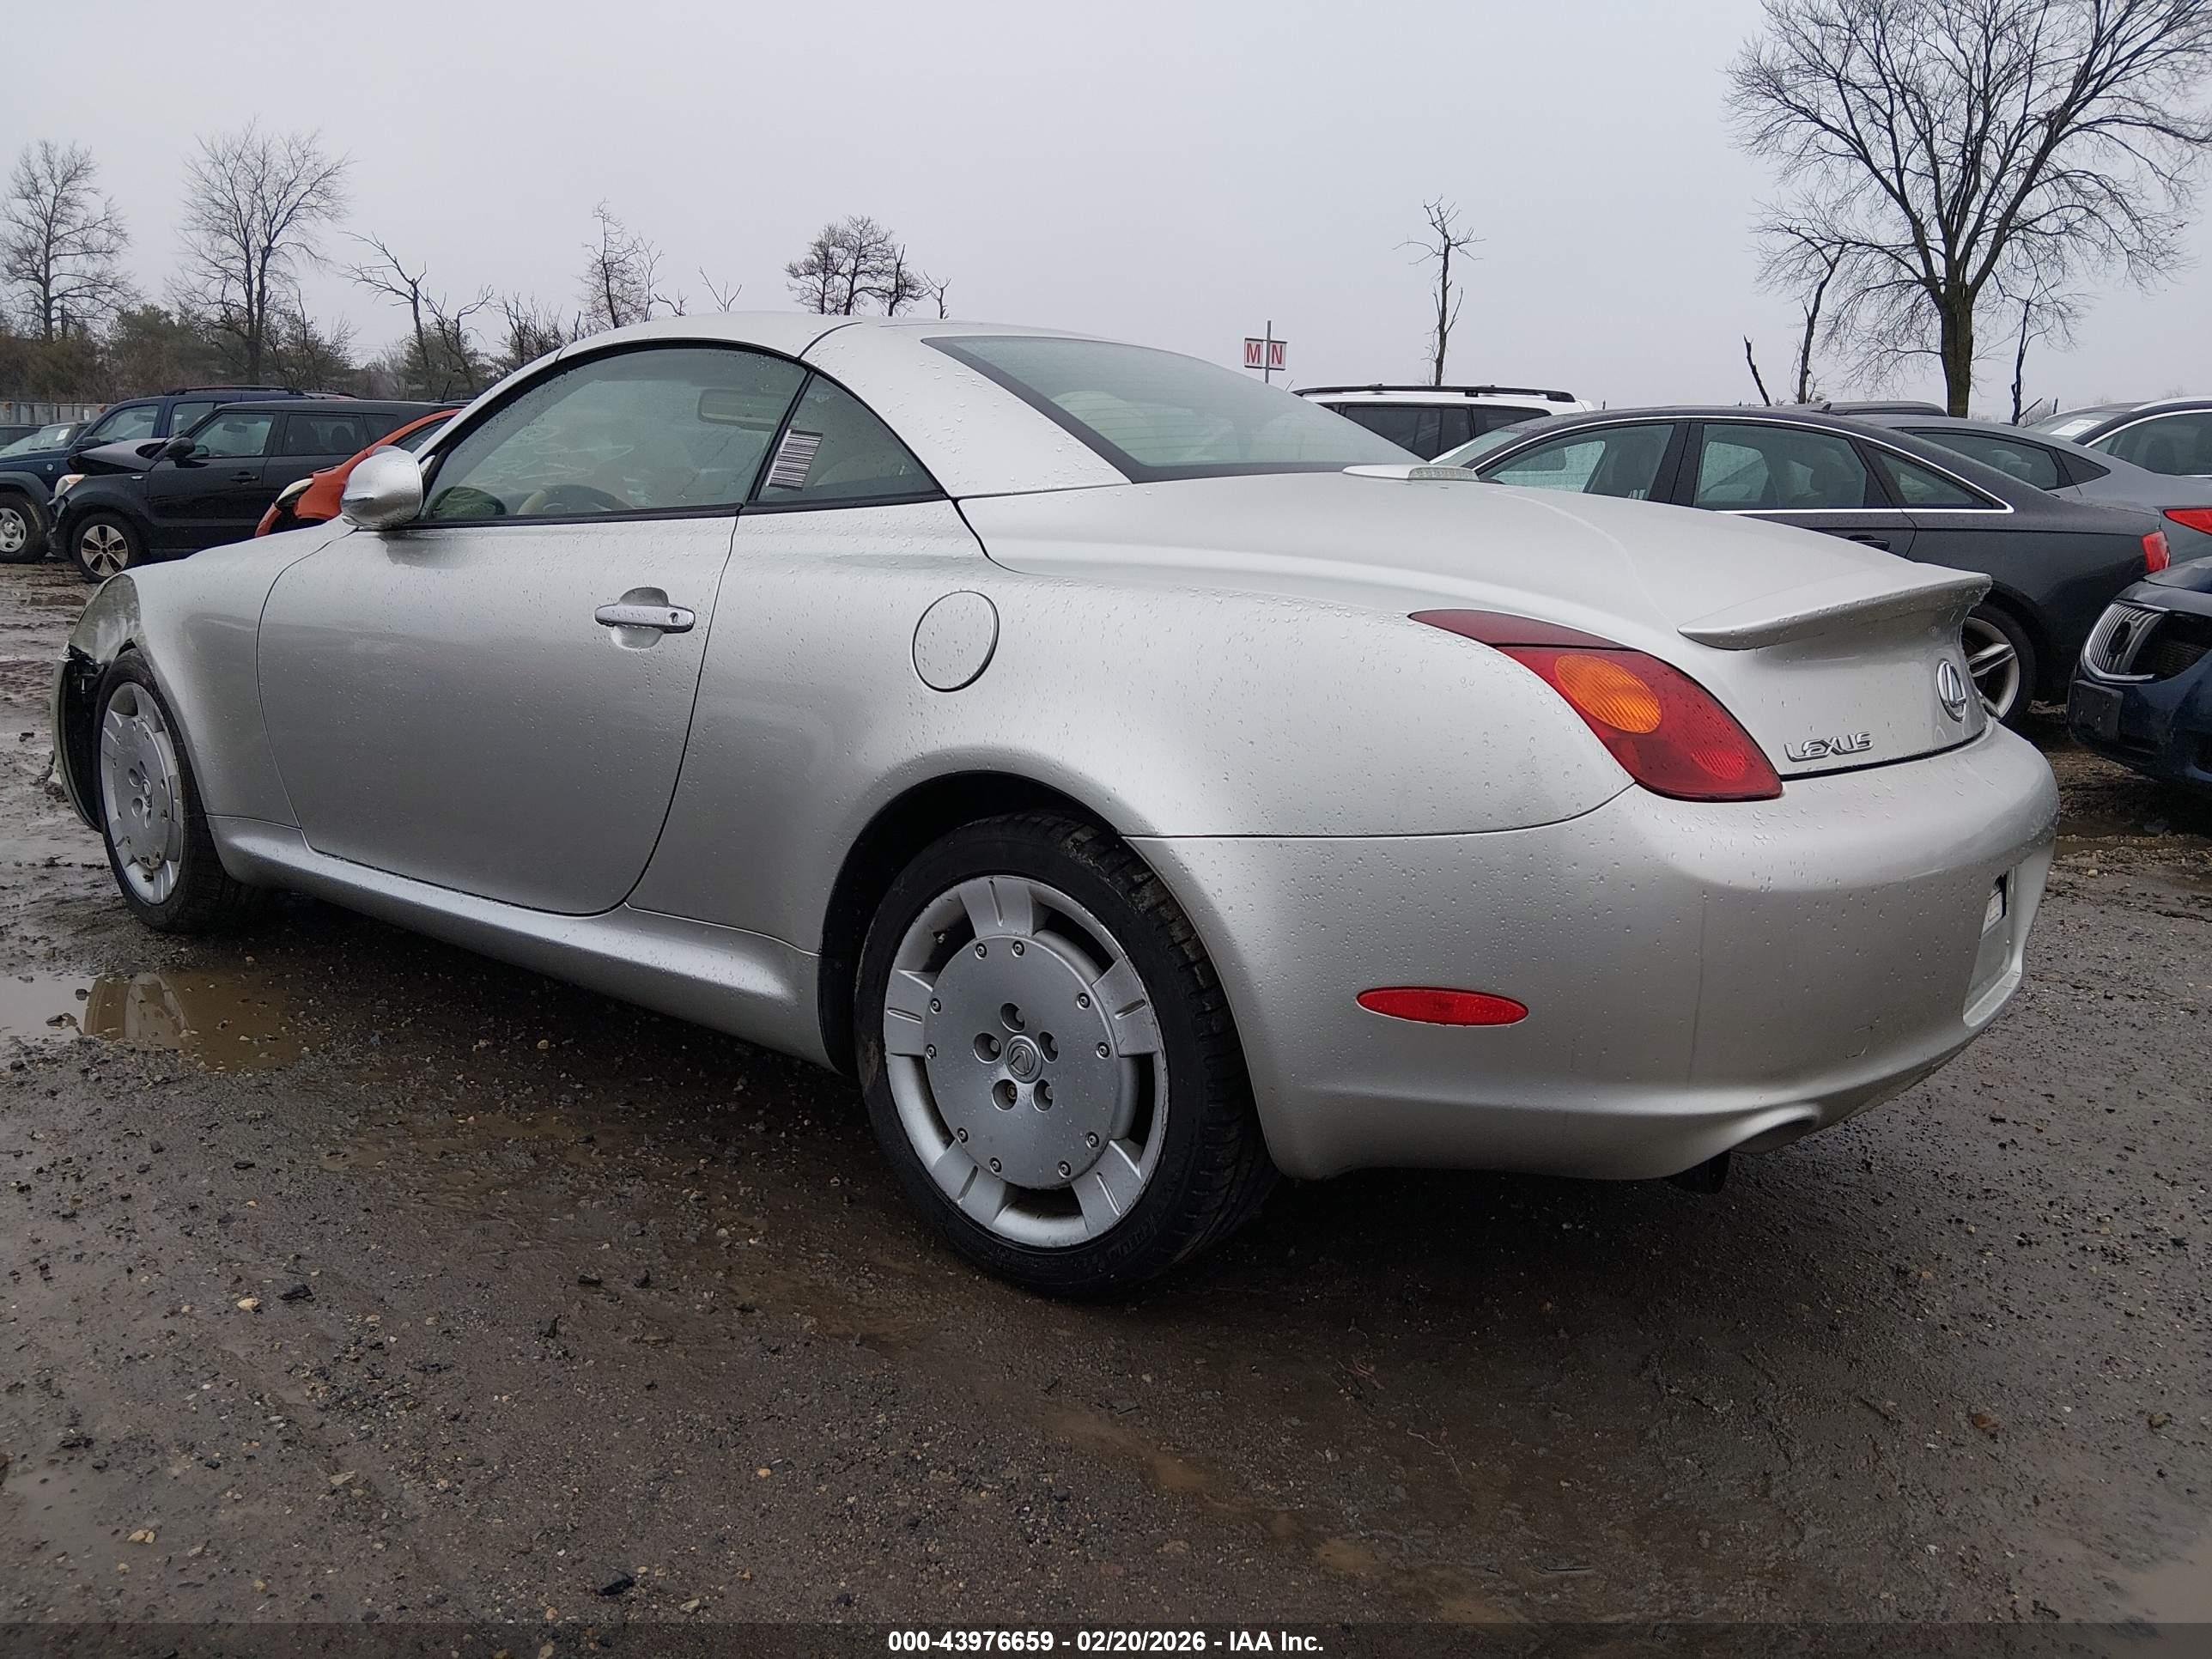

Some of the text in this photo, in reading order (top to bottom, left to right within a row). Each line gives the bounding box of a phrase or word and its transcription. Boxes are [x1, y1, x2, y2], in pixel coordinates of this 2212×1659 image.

[1247, 343, 1261, 364] M
[1271, 344, 1283, 365] N
[1784, 732, 1874, 763] LEXUS
